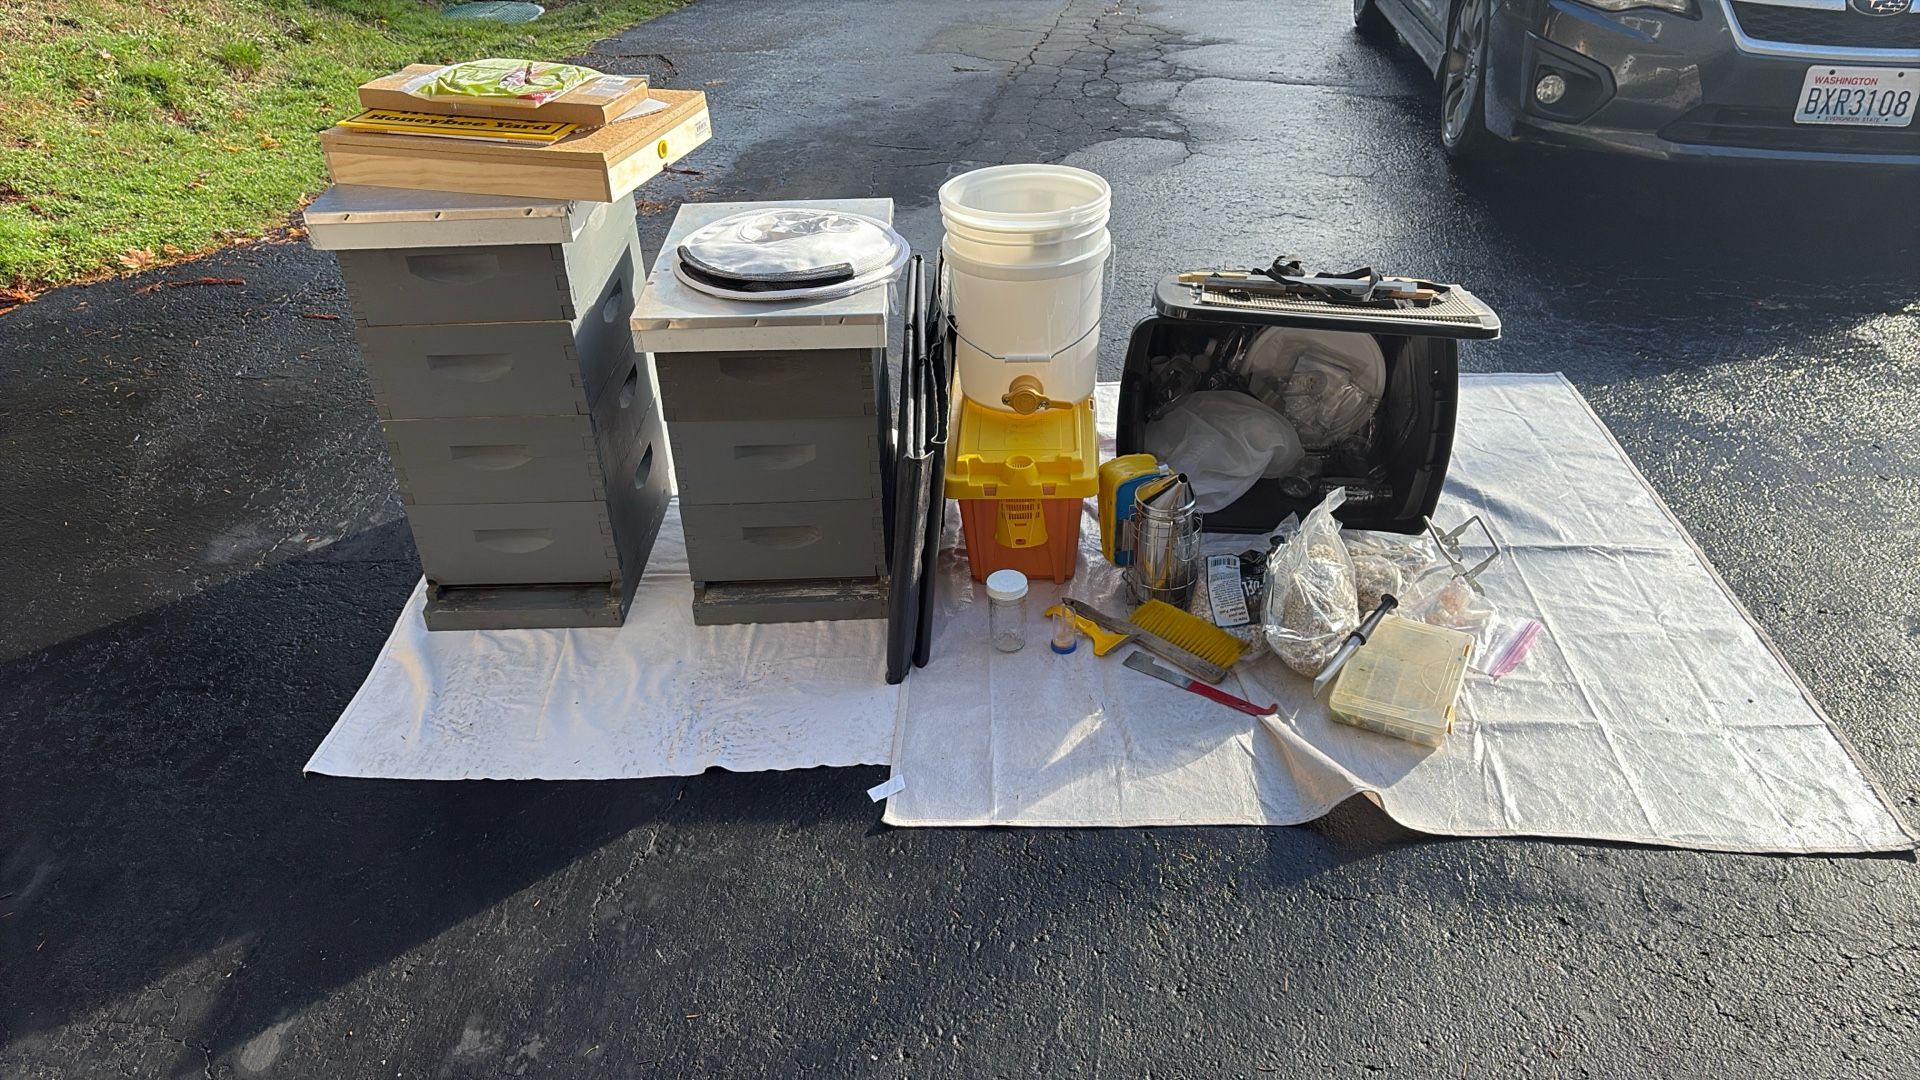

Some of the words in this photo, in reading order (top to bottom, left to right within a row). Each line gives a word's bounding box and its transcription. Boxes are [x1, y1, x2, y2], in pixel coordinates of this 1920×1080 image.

[1814, 76, 1879, 86] WASHINGTON
[1804, 87, 1912, 117] BXR3108
[367, 113, 487, 127] Honeybee
[495, 120, 552, 131] Yard
